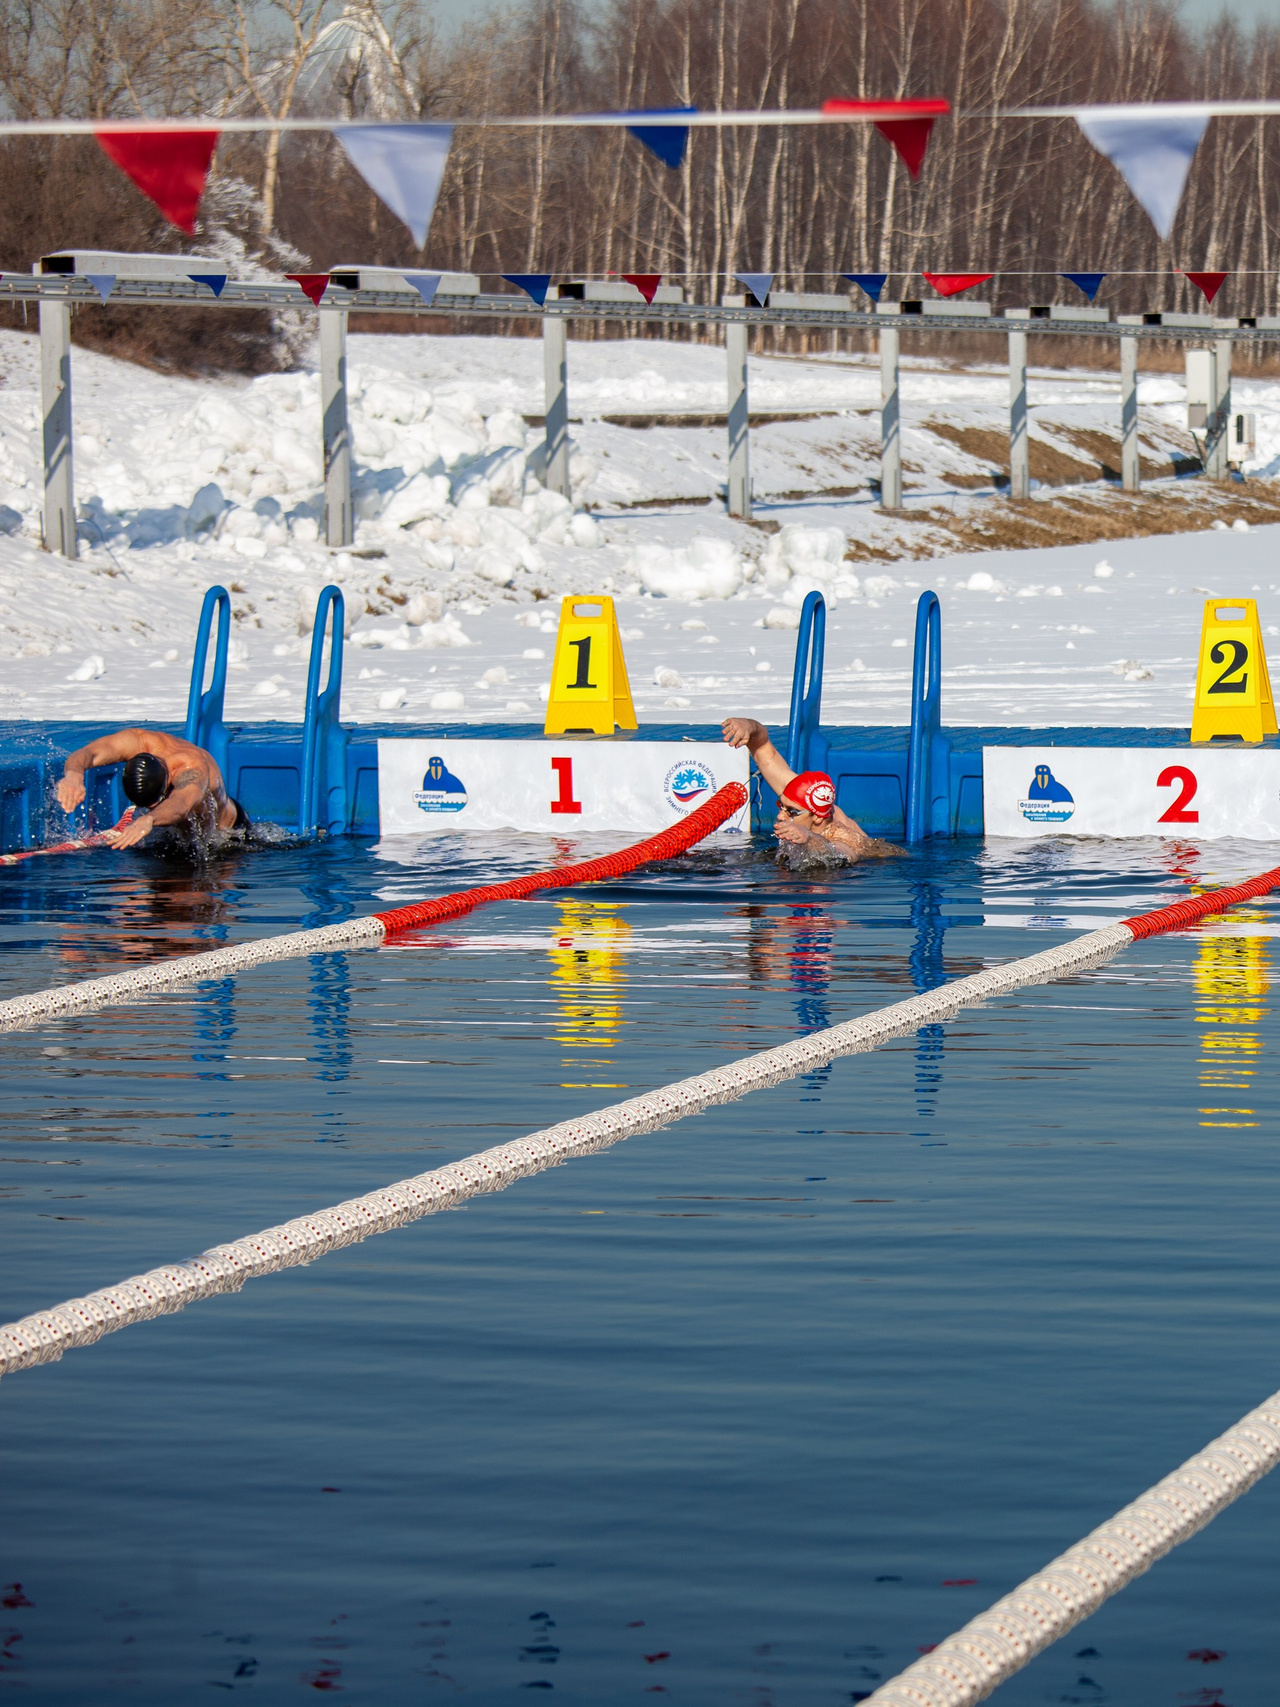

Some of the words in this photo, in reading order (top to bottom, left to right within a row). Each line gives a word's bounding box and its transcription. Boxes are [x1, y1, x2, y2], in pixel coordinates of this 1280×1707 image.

[566, 636, 597, 689] 1
[1207, 640, 1249, 694] 2
[550, 756, 583, 815] 1
[664, 760, 697, 793] ВСЕРОССИЙСКАЯ
[1156, 765, 1200, 824] 2
